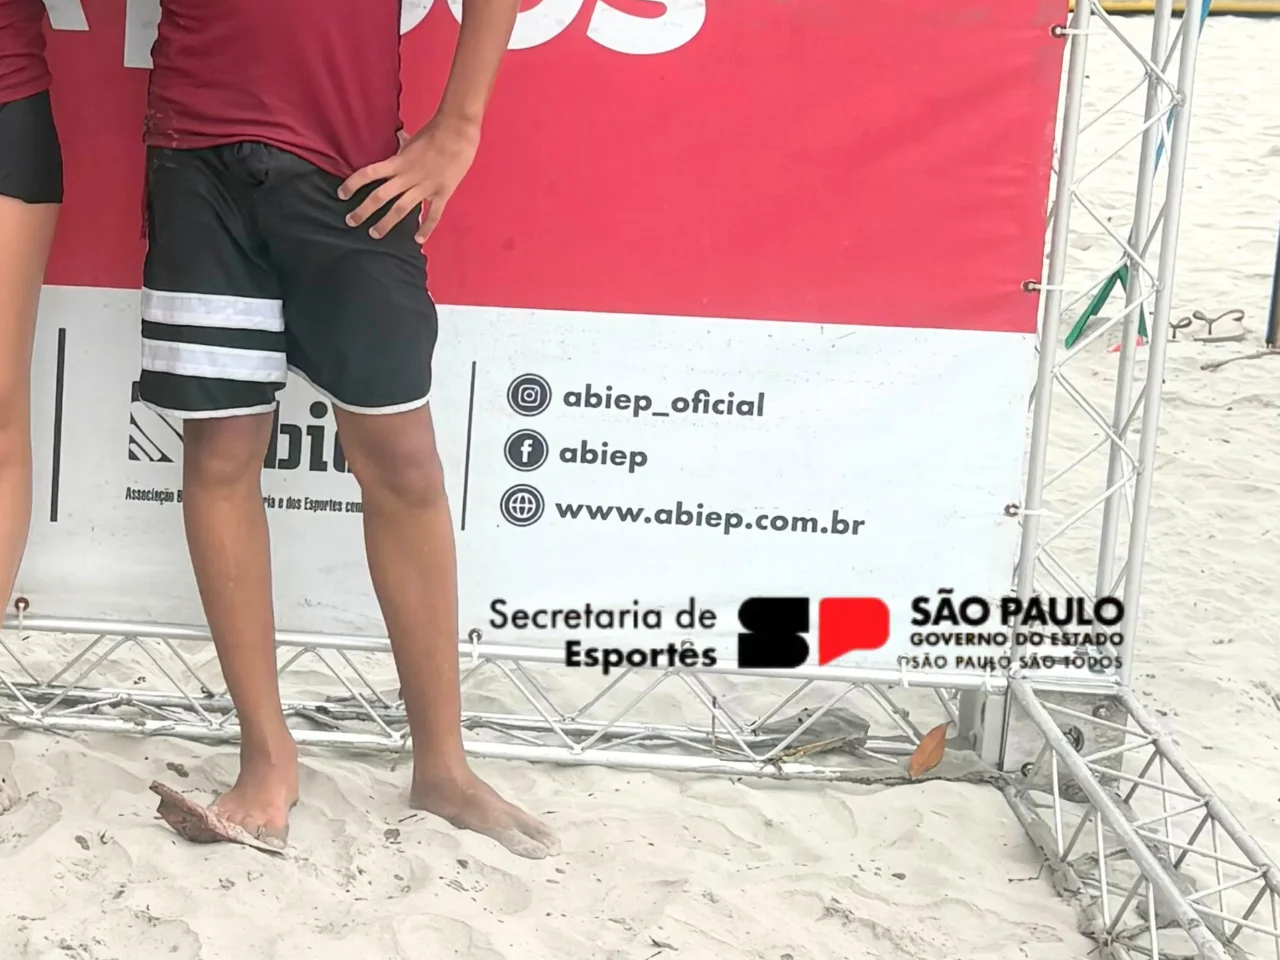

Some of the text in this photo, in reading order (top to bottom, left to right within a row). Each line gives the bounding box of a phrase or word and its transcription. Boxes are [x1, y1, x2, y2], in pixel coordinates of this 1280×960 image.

[562, 383, 766, 418] abiep_oficial
[558, 440, 649, 473] abiep
[286, 496, 302, 510] dos
[304, 497, 343, 513] Esportes
[554, 500, 866, 536] www.abiep.com.br
